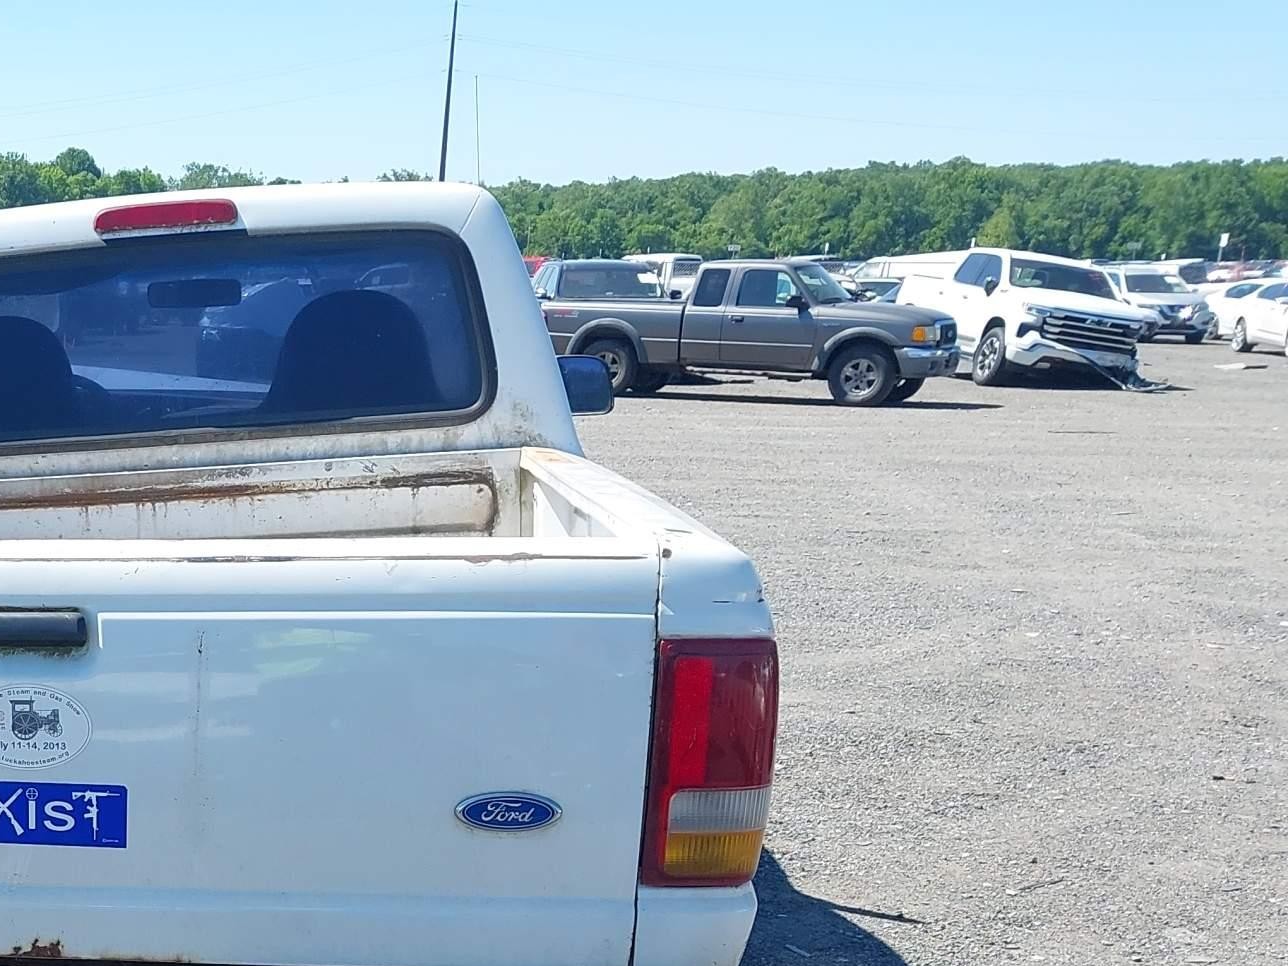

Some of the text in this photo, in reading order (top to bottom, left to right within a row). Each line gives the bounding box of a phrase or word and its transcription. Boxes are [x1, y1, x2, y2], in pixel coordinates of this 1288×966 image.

[49, 693, 63, 702] Gas
[11, 741, 41, 752] 11-14,
[43, 742, 67, 751] 2013
[481, 801, 535, 822] Ford
